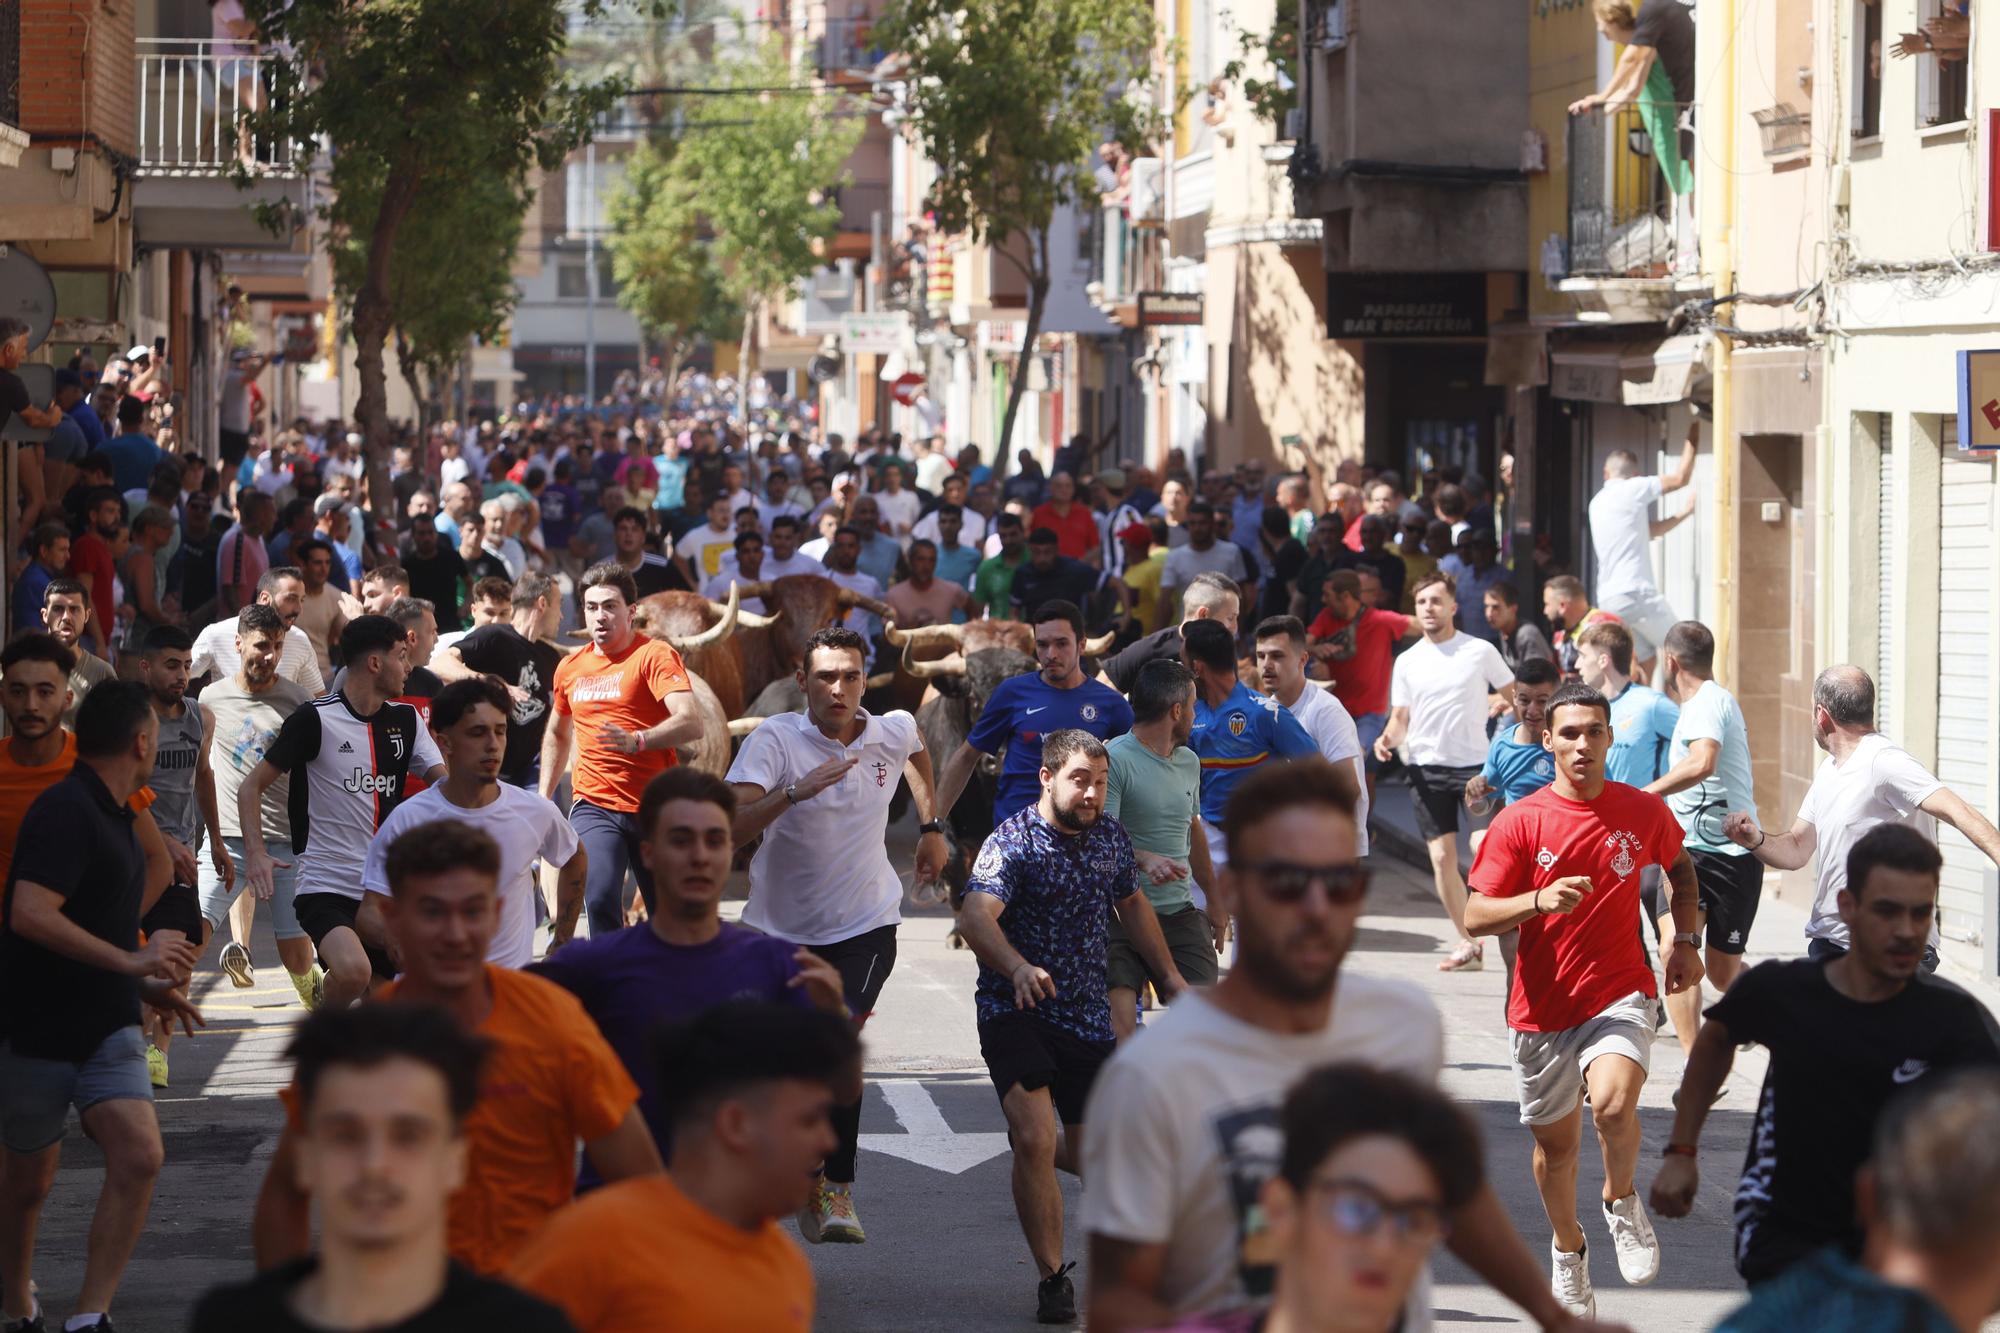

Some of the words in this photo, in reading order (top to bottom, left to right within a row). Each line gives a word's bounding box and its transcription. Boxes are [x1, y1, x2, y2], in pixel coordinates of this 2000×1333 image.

[1364, 303, 1453, 317] PAPARAZZI
[1343, 319, 1377, 333] BAR
[1382, 318, 1472, 332] BOCATERIA
[344, 767, 396, 797] Jeep
[1605, 830, 1643, 851] 2019-2023
